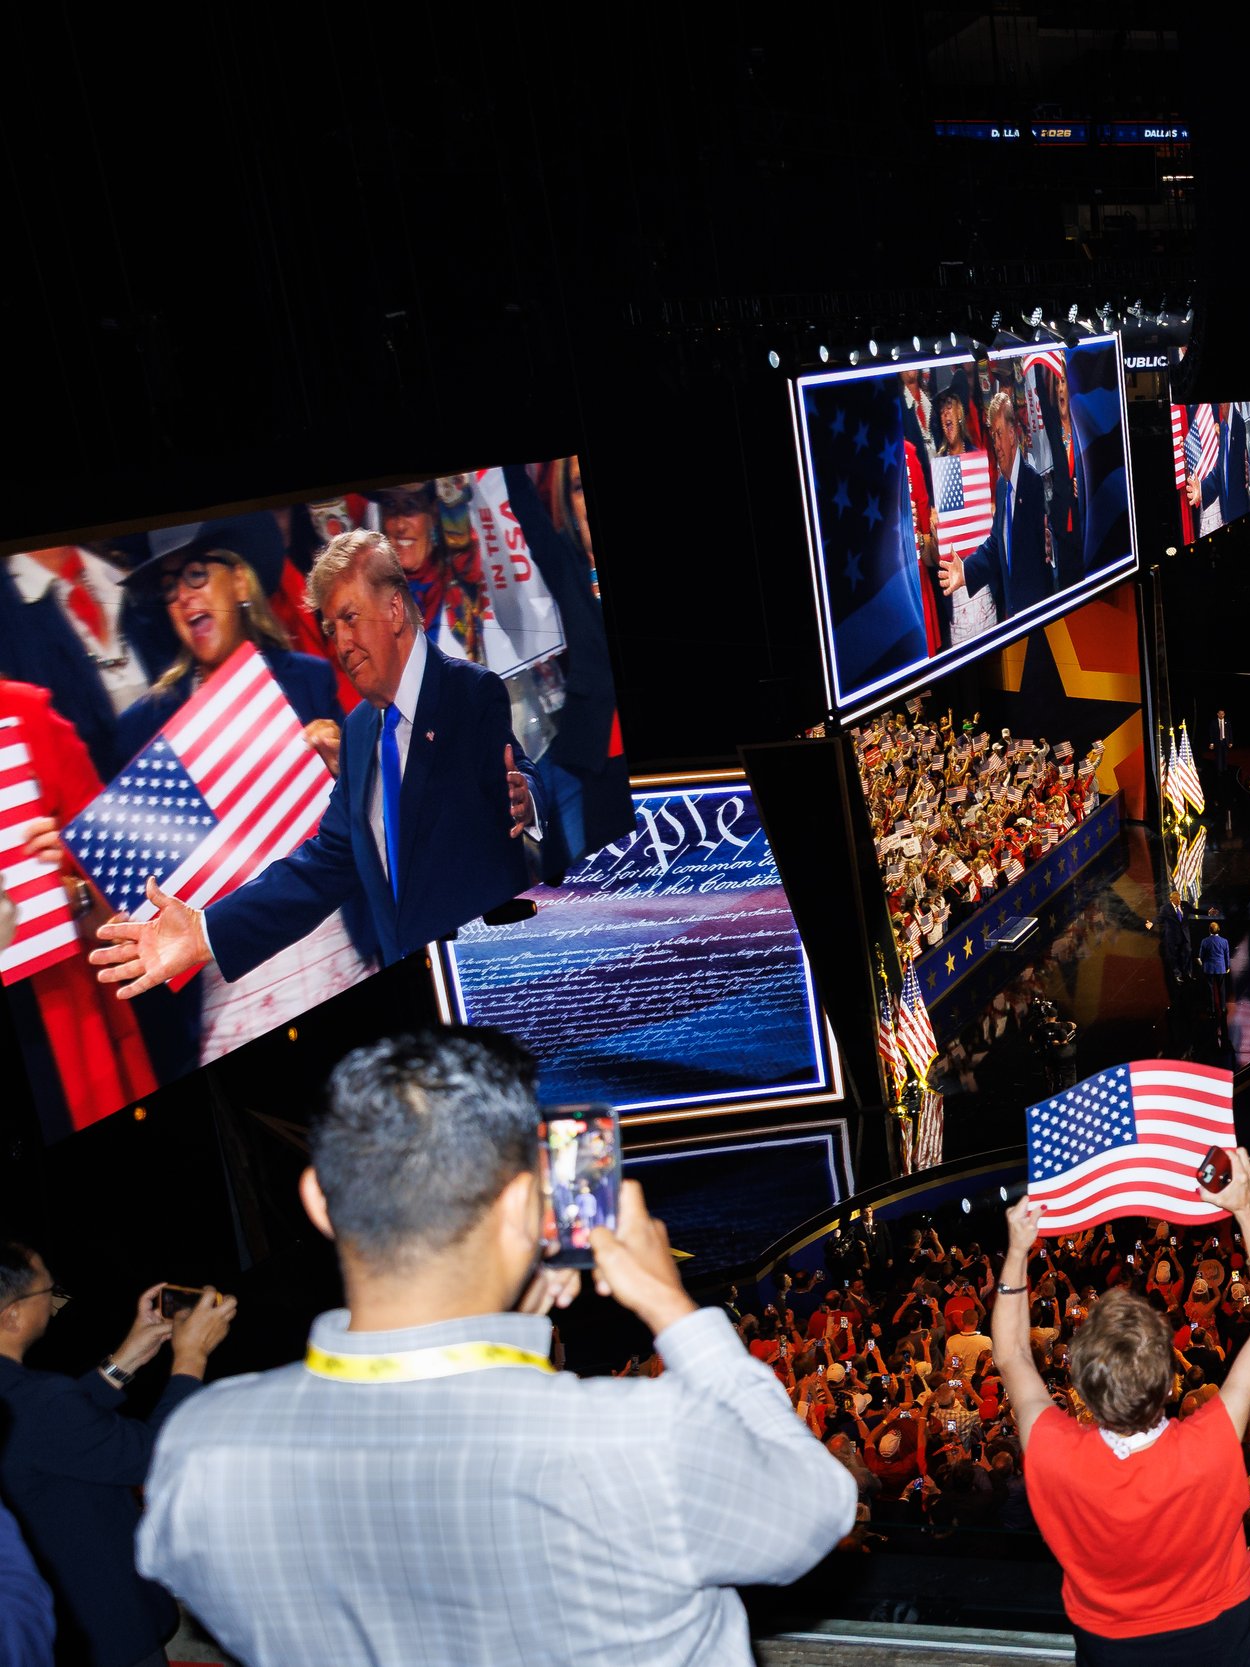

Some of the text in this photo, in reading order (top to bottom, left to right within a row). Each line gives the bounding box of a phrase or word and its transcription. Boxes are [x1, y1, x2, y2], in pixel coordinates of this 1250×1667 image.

[1144, 129, 1178, 138] DALLAS
[479, 508, 499, 557] THE
[499, 501, 532, 582] USA
[491, 564, 508, 589] IN
[672, 860, 757, 875] common
[569, 882, 659, 905] establish
[658, 875, 695, 897] this
[698, 872, 783, 894] Constitu
